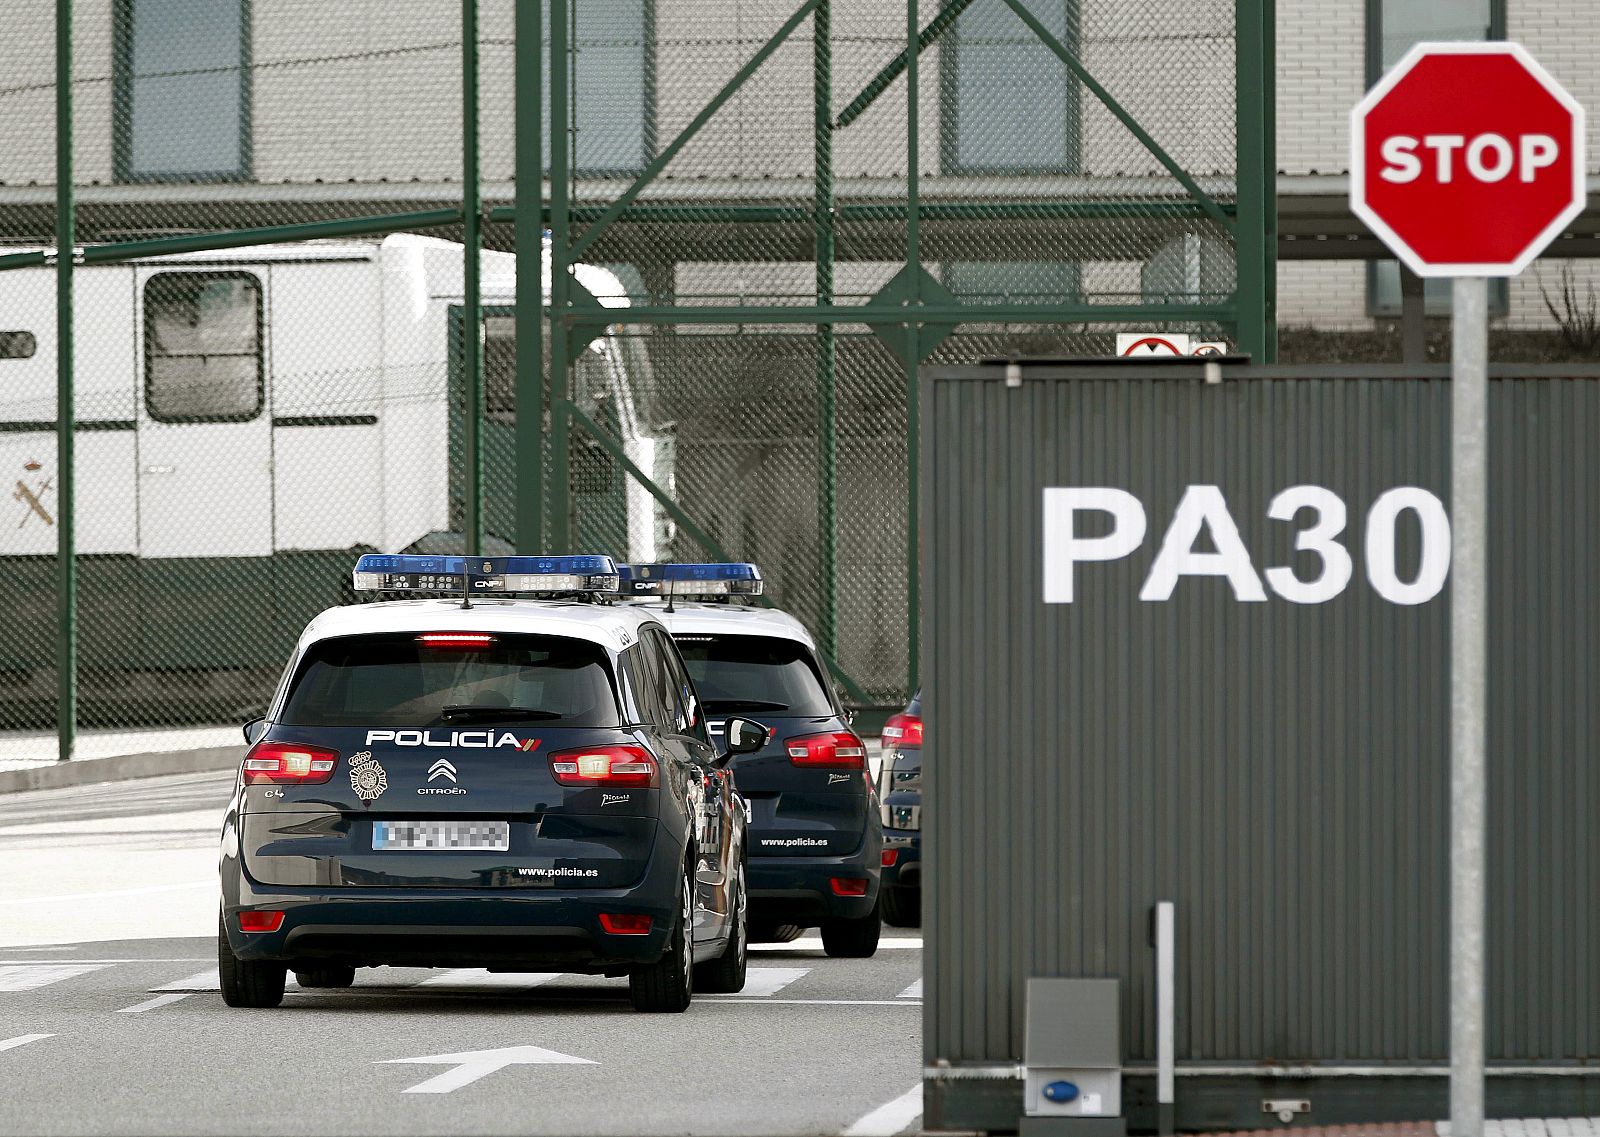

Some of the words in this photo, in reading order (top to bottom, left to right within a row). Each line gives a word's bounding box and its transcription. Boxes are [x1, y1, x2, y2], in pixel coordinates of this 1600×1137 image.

[1379, 132, 1560, 184] STOP
[1042, 484, 1452, 606] PA30
[365, 728, 523, 748] POLICÍA
[264, 789, 285, 798] C4
[417, 787, 467, 795] CITROËN
[761, 837, 828, 848] www.policia.es
[518, 867, 599, 878] www.policia.es
